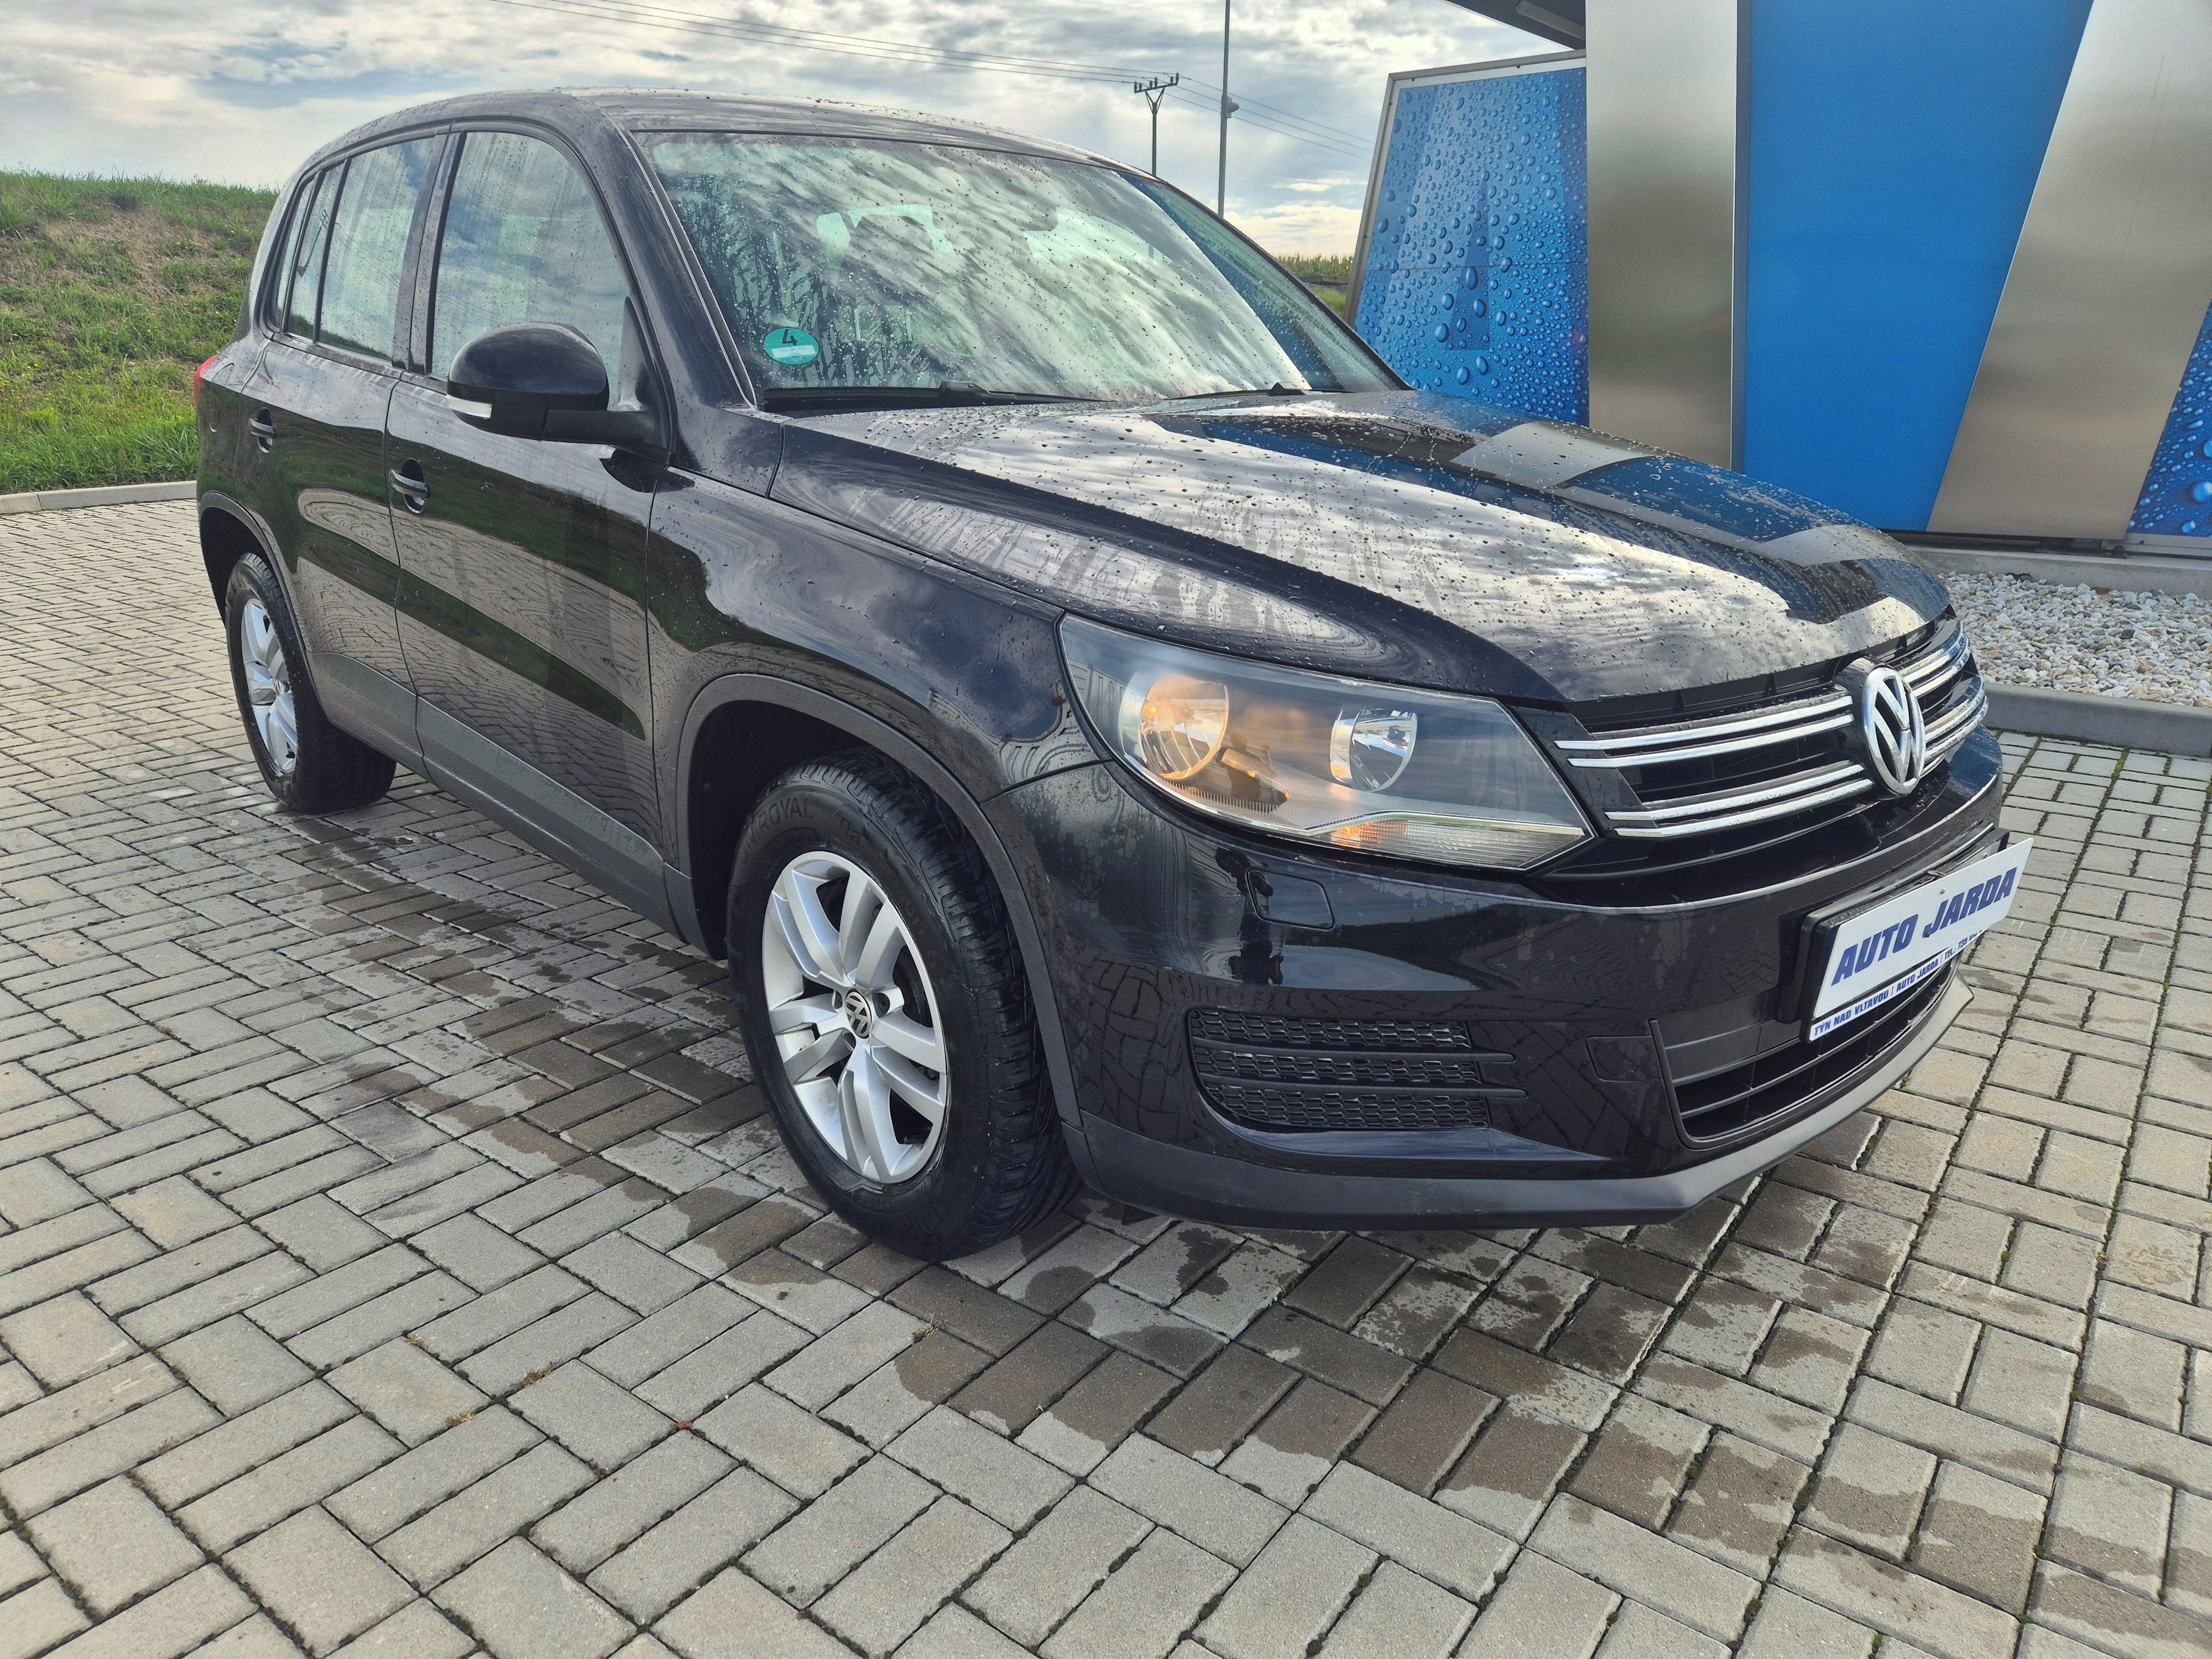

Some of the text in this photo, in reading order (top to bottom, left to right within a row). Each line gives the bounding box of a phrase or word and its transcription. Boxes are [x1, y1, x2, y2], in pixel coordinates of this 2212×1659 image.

[782, 329, 797, 345] 4
[1831, 867, 2017, 986] AUTO JARDA
[1834, 1009, 1852, 1026] NAD
[1855, 989, 1890, 1015] VLTAVOU
[1896, 974, 1915, 992] AUTO
[1917, 958, 1939, 979] JARDA
